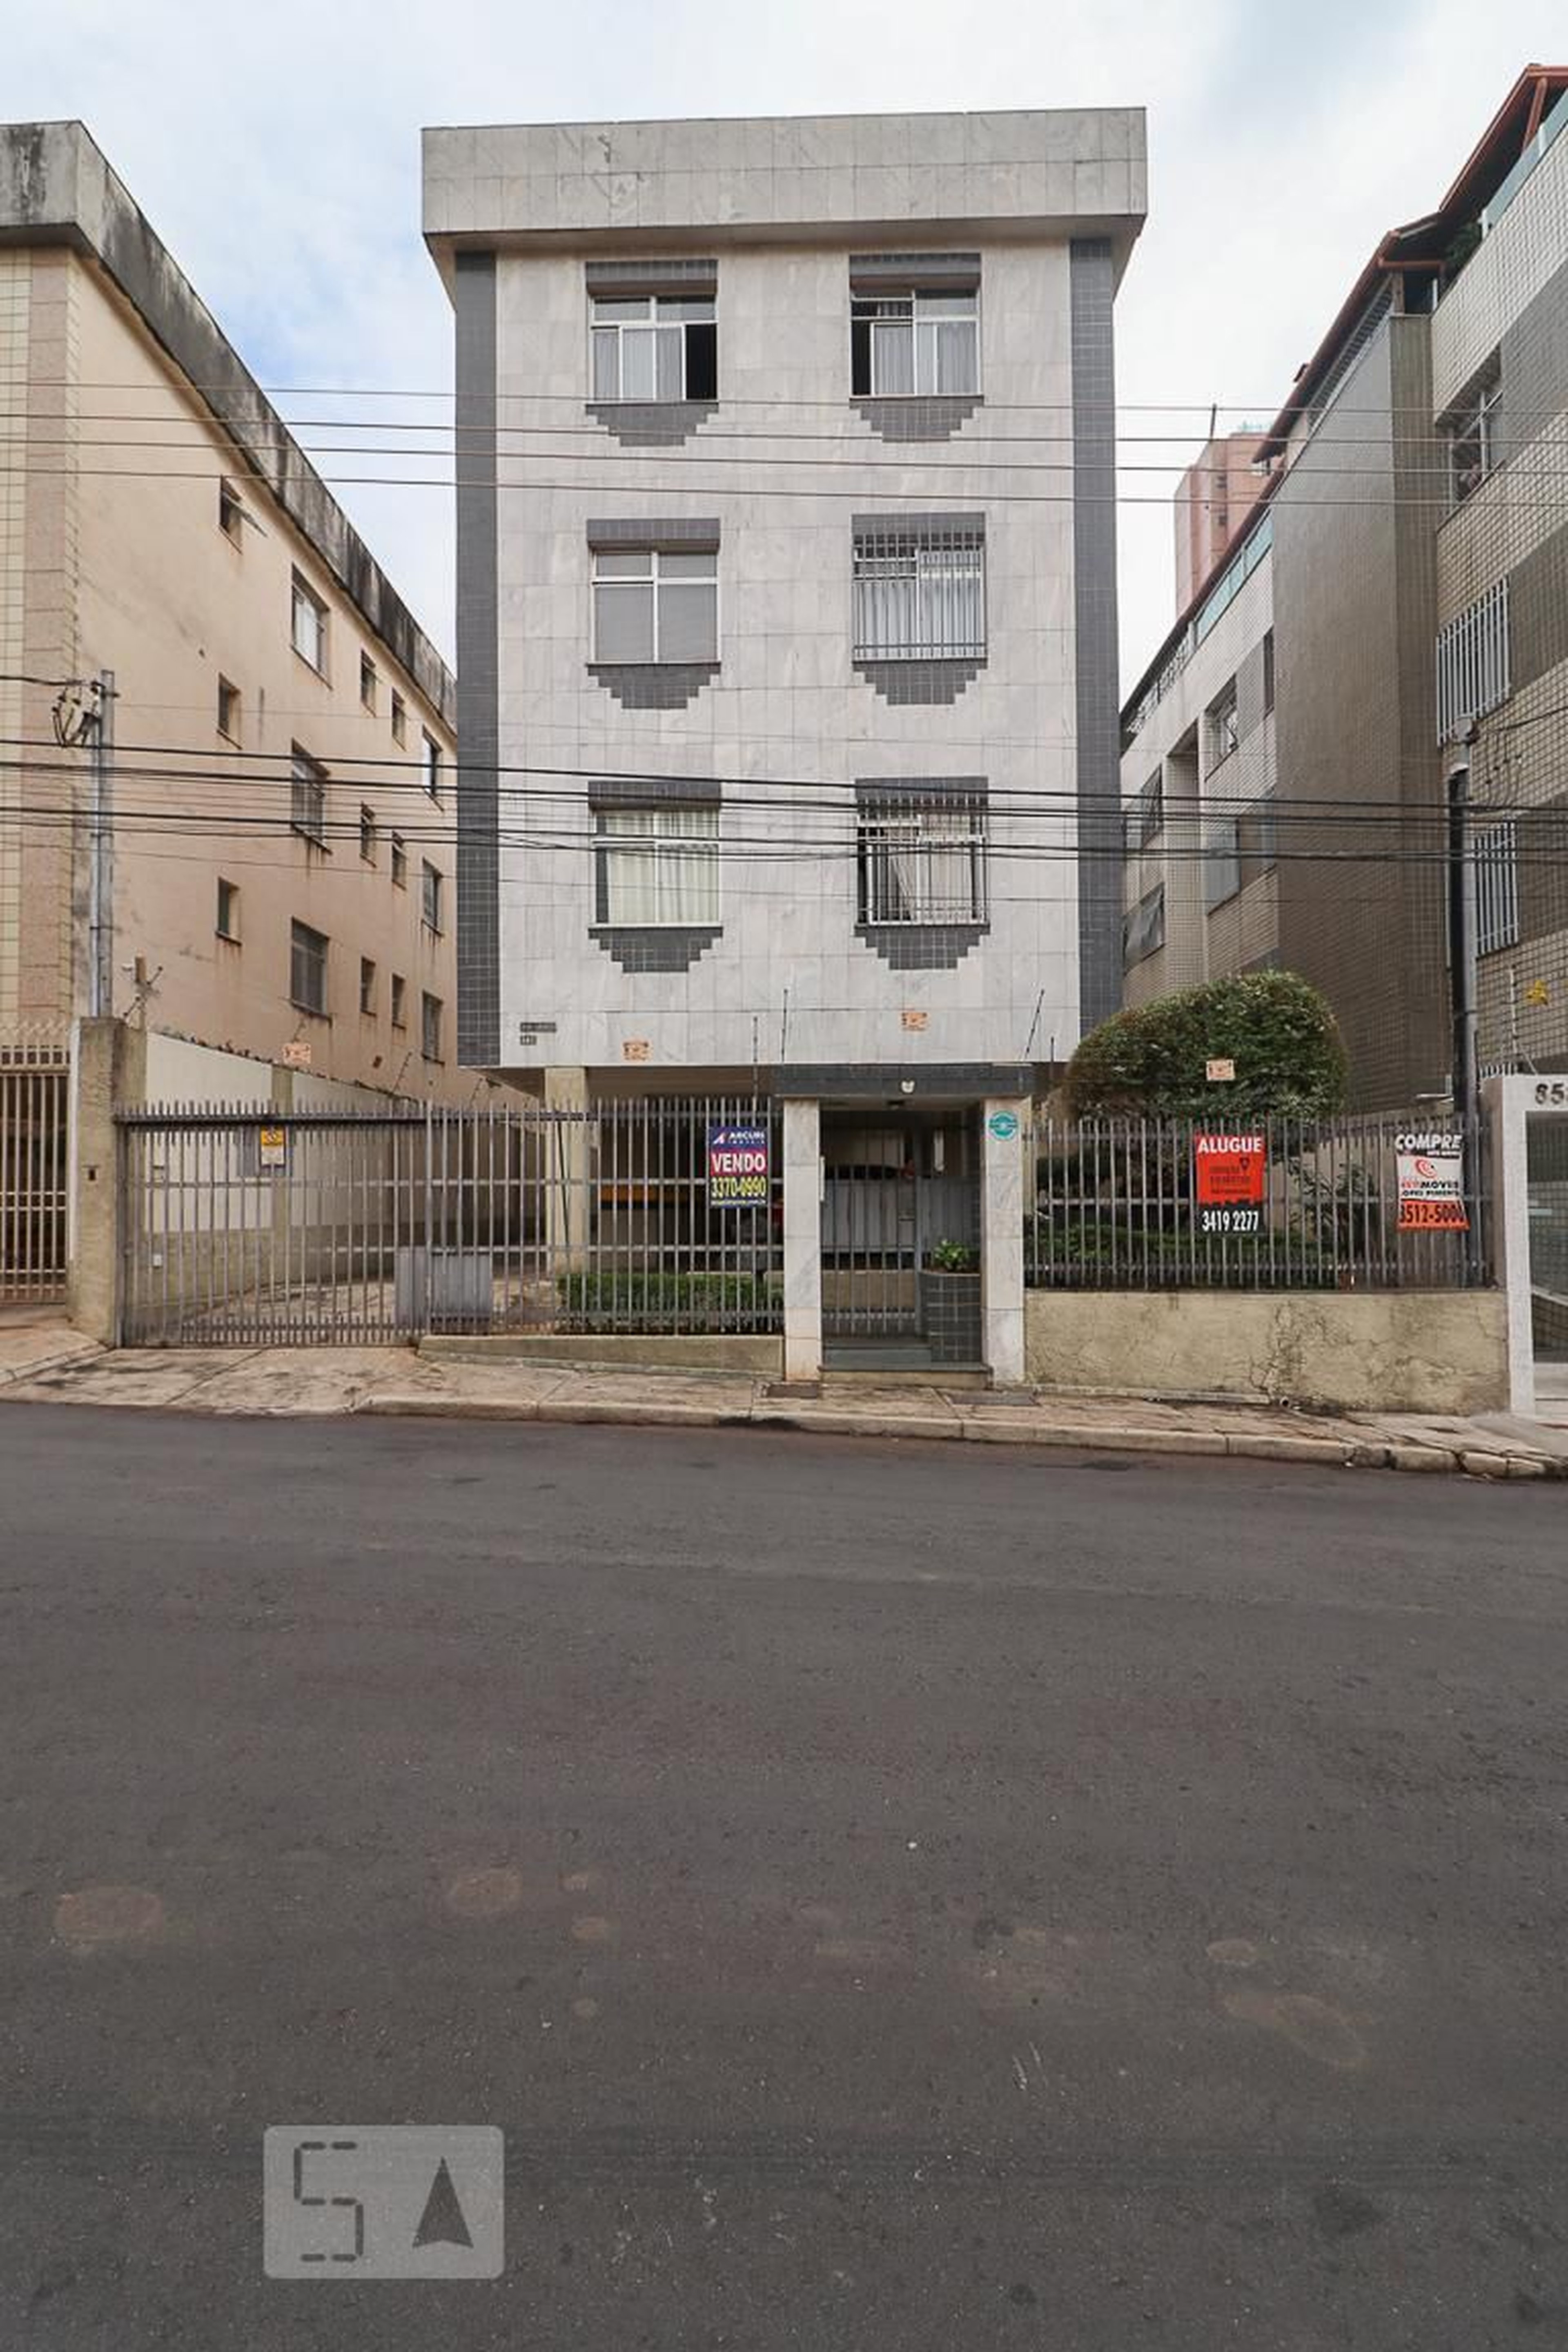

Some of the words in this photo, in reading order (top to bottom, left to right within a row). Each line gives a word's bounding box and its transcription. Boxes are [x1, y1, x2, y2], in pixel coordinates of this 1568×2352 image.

[1198, 1137, 1263, 1154] ALUGUE
[1395, 1134, 1463, 1150] COMPRE
[711, 1152, 766, 1173] VENDO
[1202, 1210, 1230, 1232] 3419
[1232, 1210, 1259, 1232] 2277
